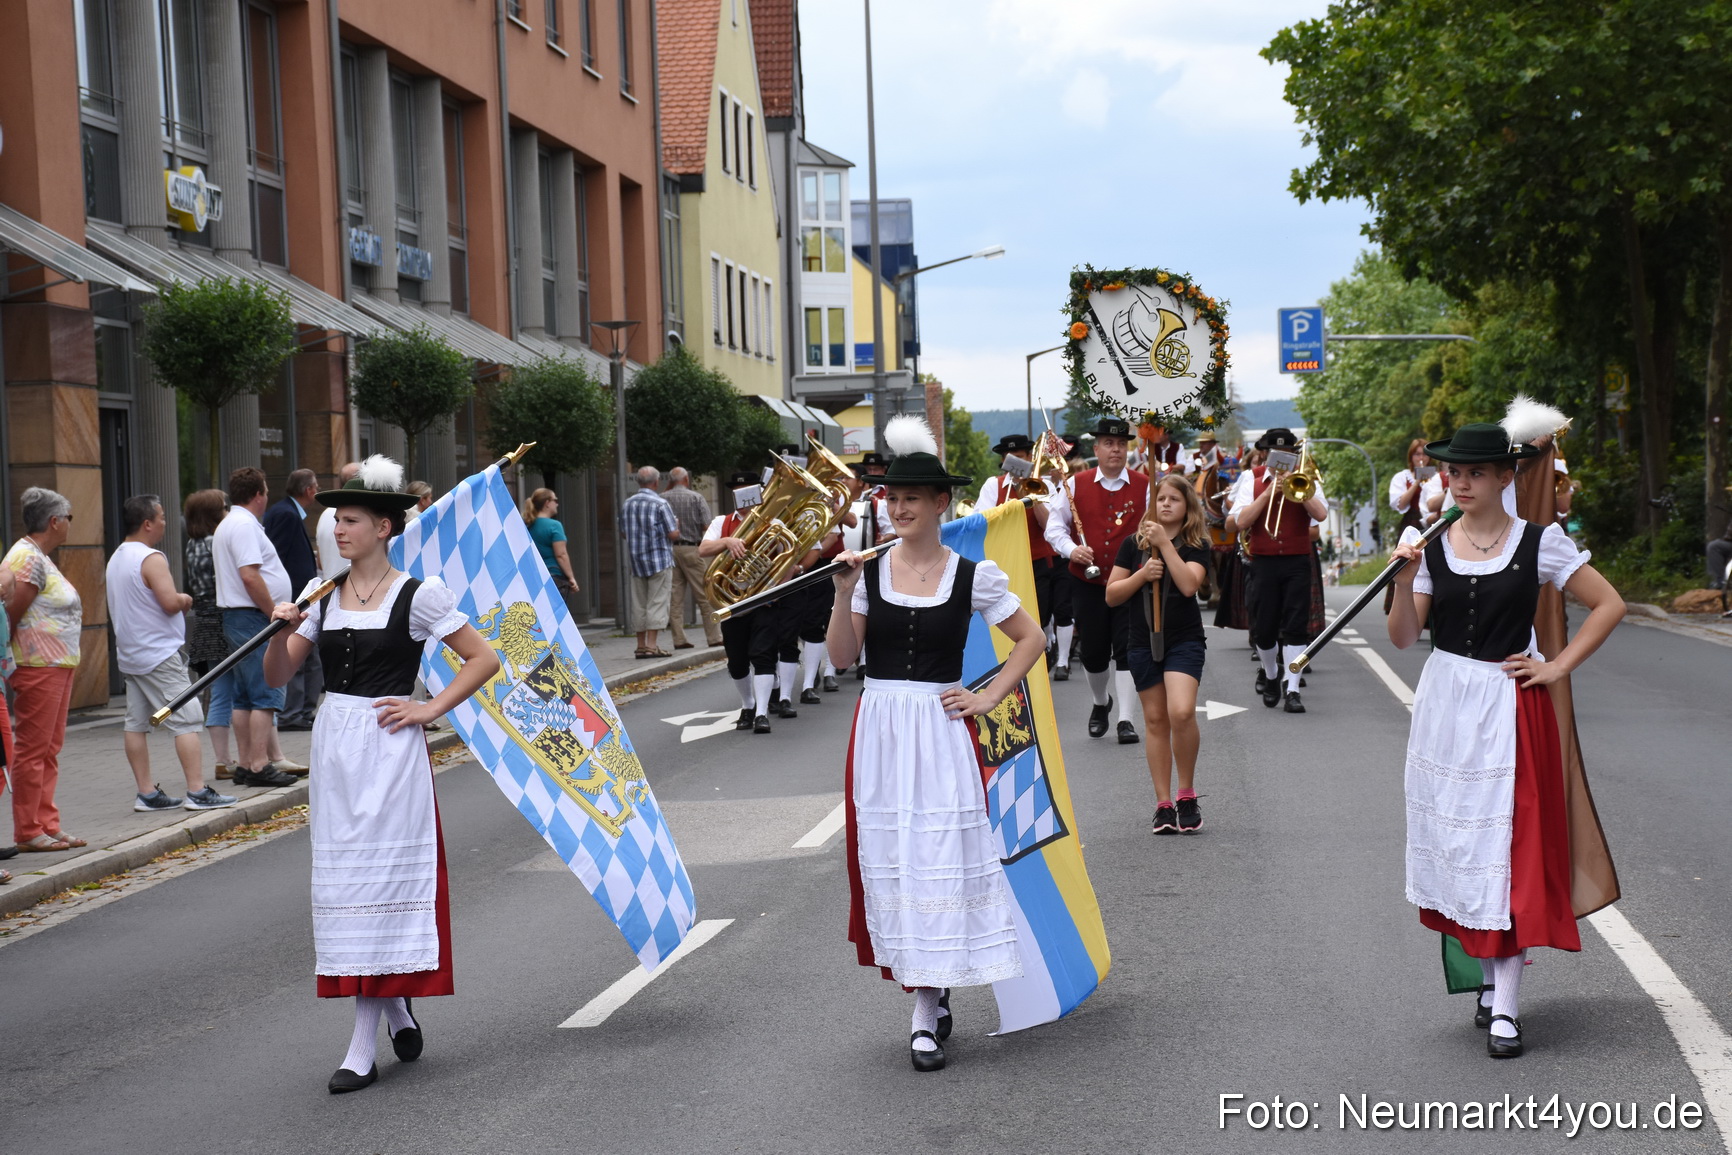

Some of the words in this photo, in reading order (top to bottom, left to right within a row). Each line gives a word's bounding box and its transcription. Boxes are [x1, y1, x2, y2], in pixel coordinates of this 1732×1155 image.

[1293, 319, 1309, 341] P
[1085, 373, 1172, 417] BLASKAPELE
[843, 445, 859, 454] ank
